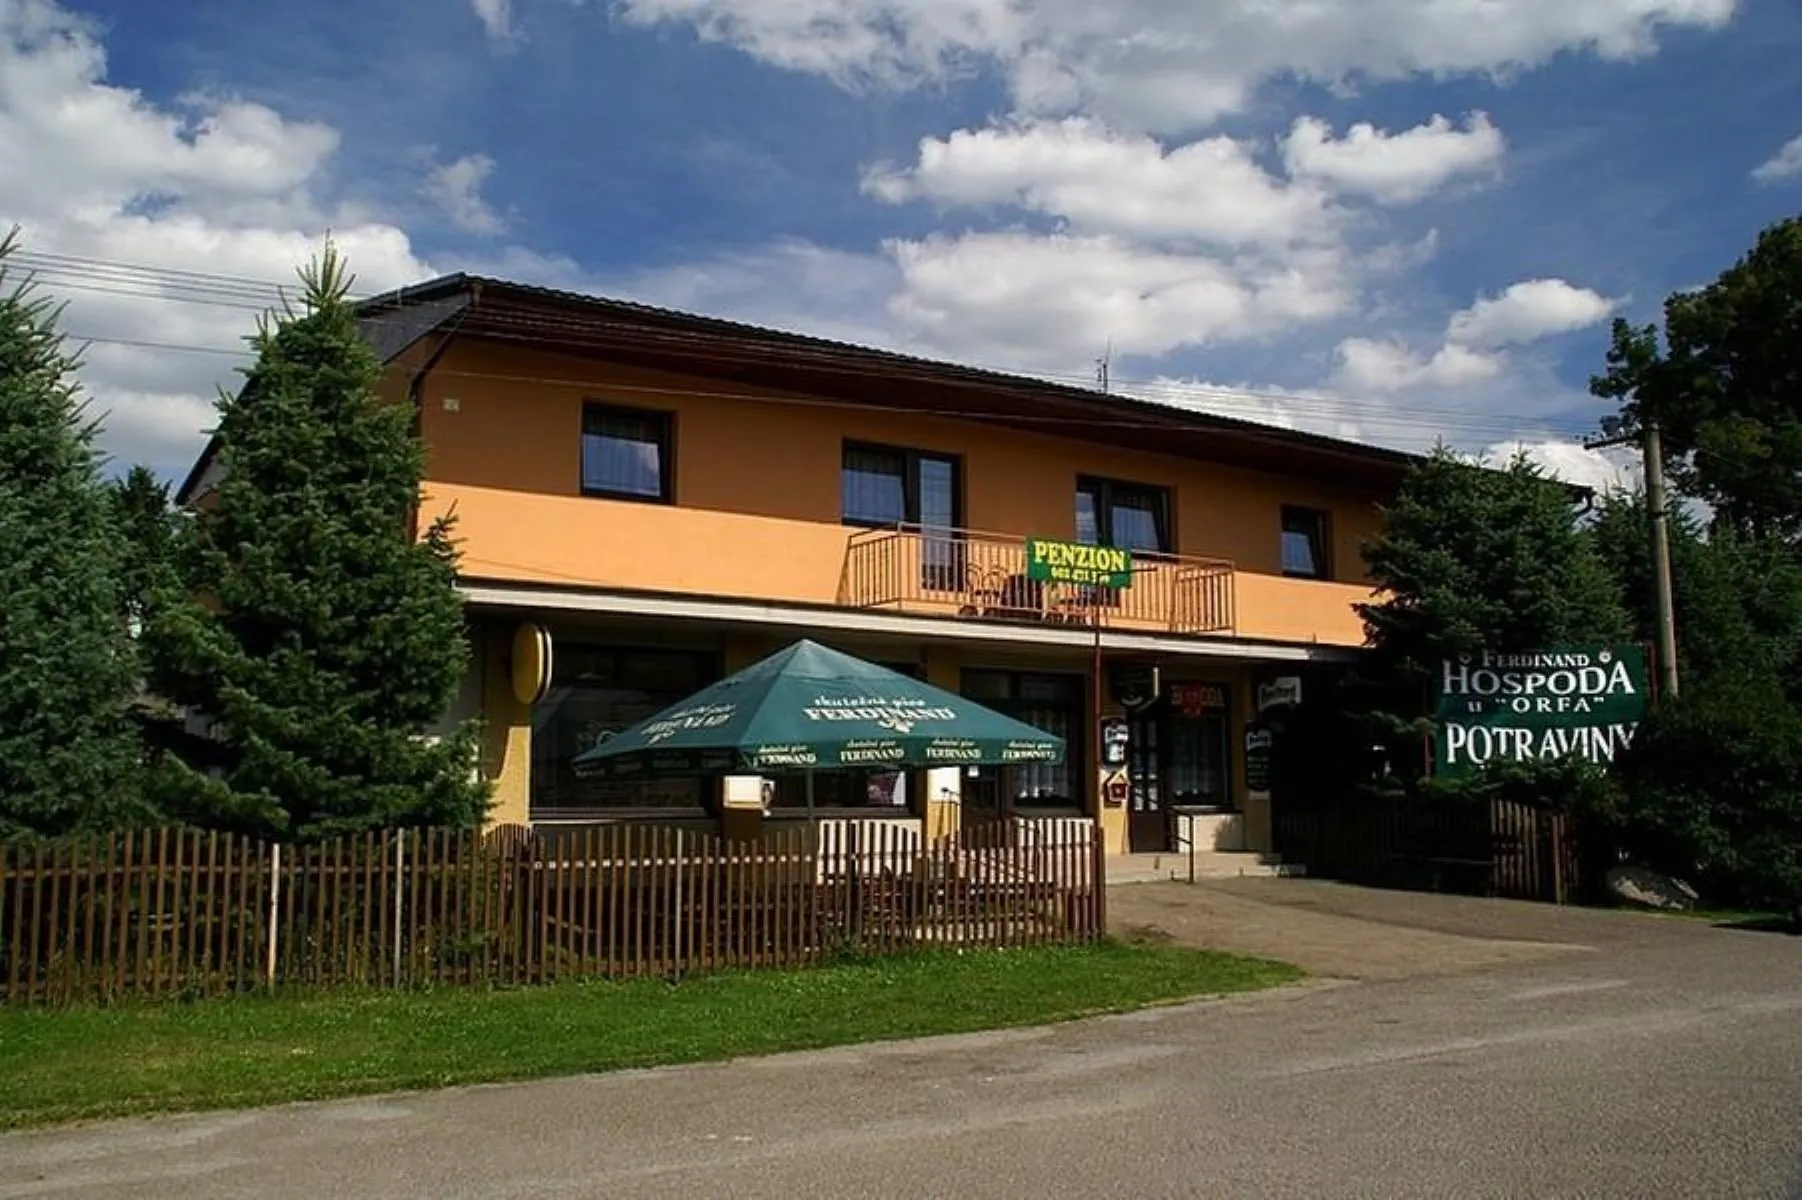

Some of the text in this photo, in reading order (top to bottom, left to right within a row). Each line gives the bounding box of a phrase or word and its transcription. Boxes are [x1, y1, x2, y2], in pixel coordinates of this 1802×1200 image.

[1033, 541, 1125, 571] PENZION
[1482, 649, 1590, 668] FERDINAND
[1442, 659, 1637, 695] HOSPODA
[802, 708, 957, 720] FERDINAND
[1445, 721, 1640, 765] POTRAVINY
